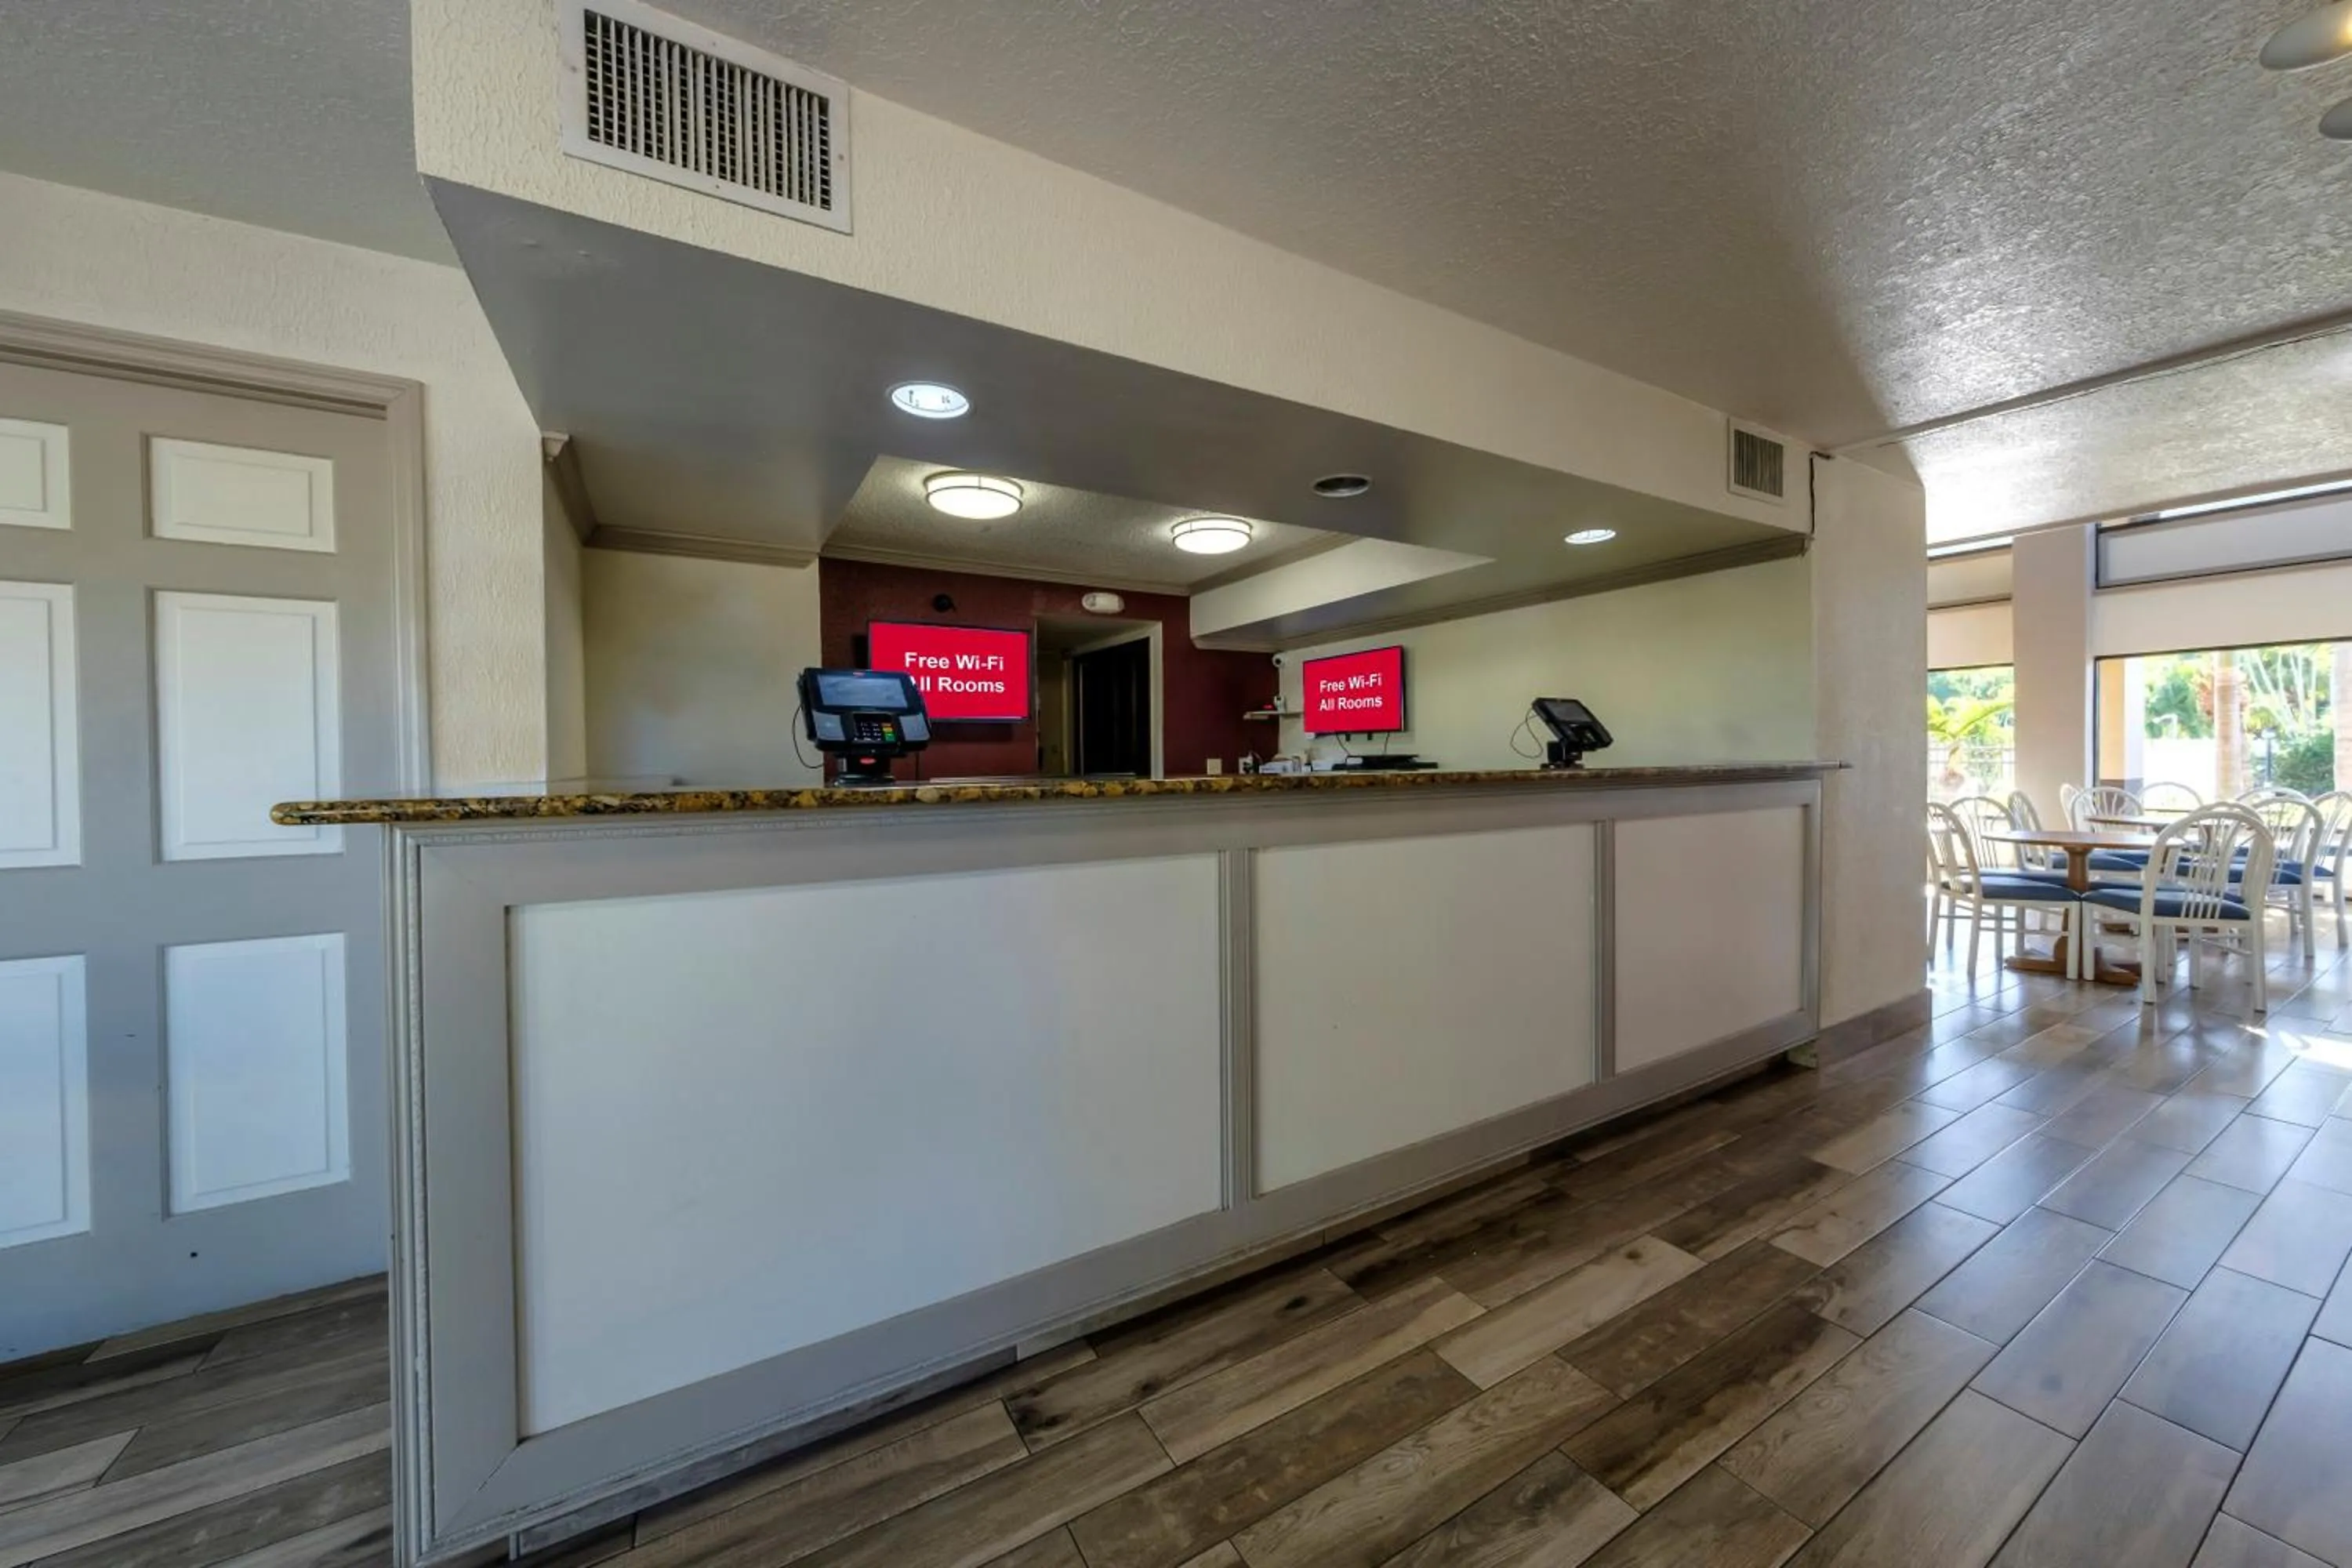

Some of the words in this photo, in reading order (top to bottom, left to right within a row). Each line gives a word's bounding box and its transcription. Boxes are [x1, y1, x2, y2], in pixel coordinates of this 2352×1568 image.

[904, 652, 950, 669] Free
[956, 654, 1004, 671] Wi-Fi
[909, 675, 931, 691] ll
[938, 677, 1005, 693] Rooms
[1319, 680, 1345, 693] Free
[1348, 673, 1382, 689] Wi-Fi
[1319, 698, 1335, 711] All
[1338, 696, 1383, 710] Rooms
